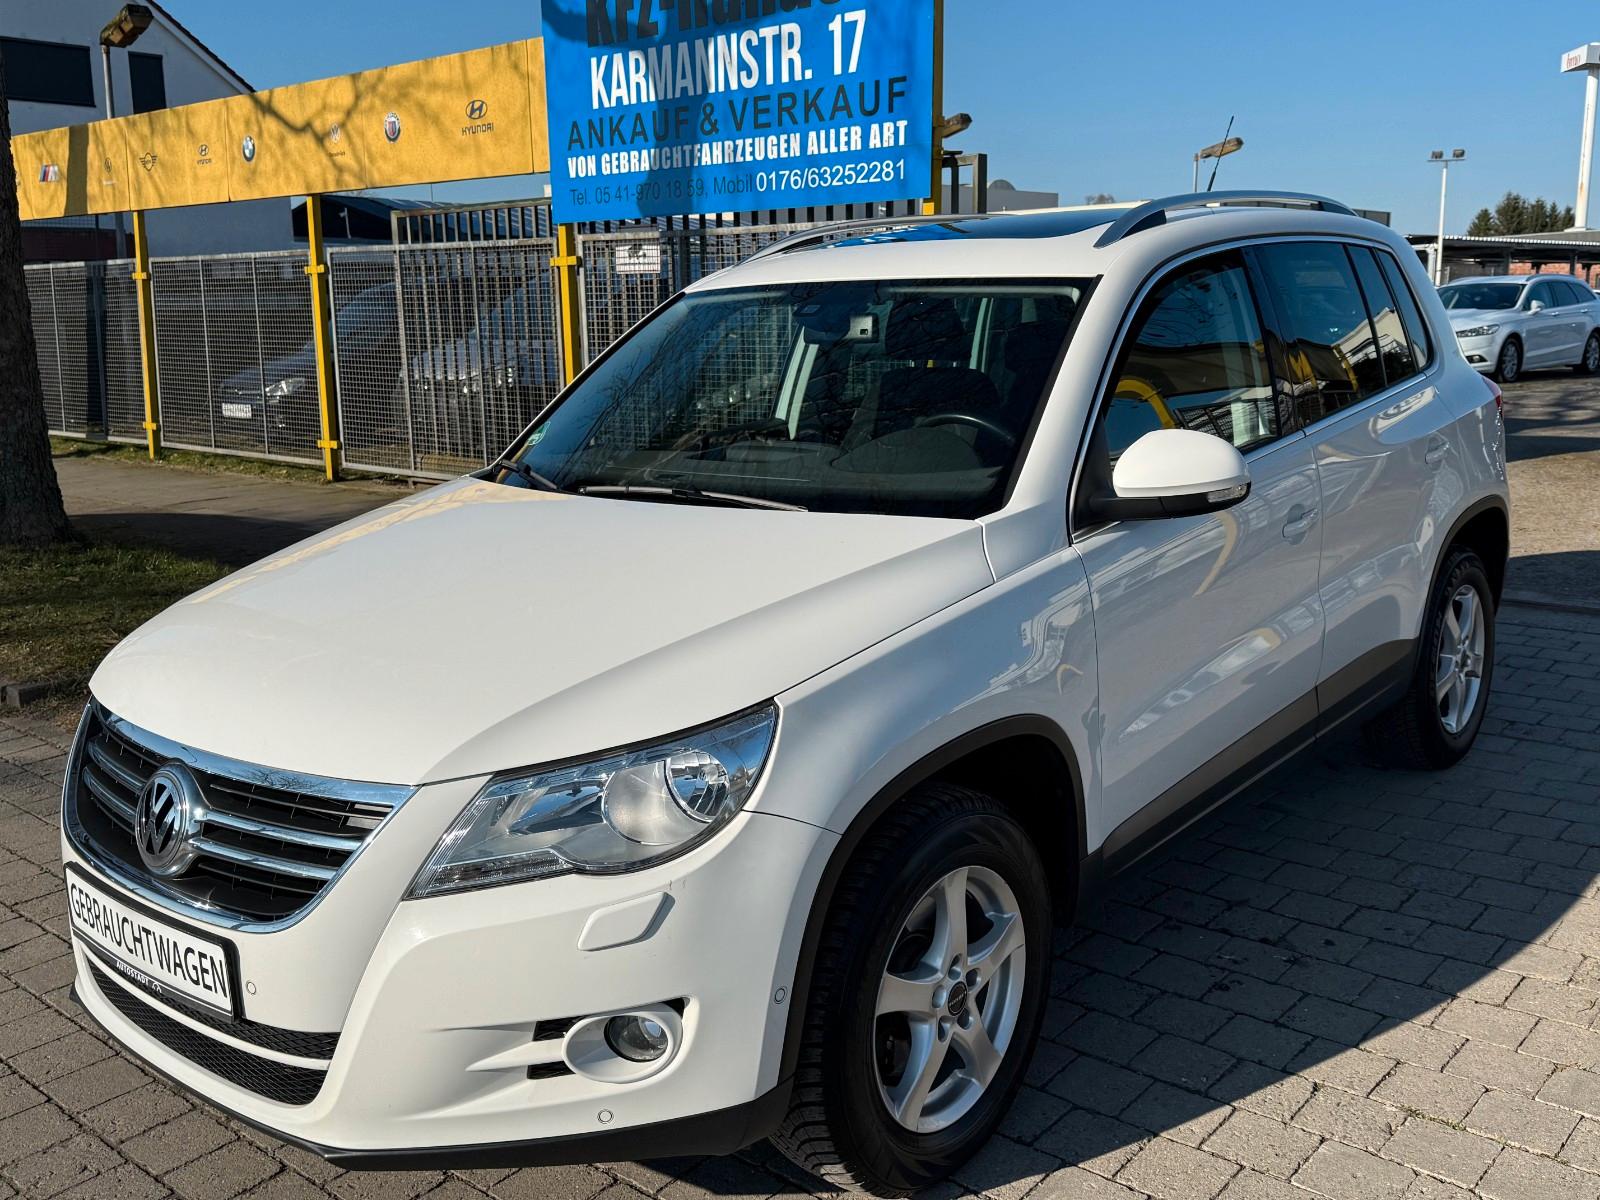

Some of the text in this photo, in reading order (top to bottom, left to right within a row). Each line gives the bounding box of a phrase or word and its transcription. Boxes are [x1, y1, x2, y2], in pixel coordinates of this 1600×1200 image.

[590, 22, 813, 110] KARMANNSTR.
[829, 9, 867, 76] 17
[461, 122, 494, 136] HYUNDAI
[568, 76, 908, 151] ANKAUF & VERKAUF
[567, 120, 908, 178] VON GEBRAUCHTFAHRZEUGEN ALLER ART
[569, 188, 591, 206] Tel.
[595, 186, 611, 204] 05
[615, 181, 661, 202] 41-970
[667, 180, 682, 198] 18
[713, 173, 753, 196] Mobil
[755, 159, 906, 193] 0176/63252281
[70, 882, 228, 999] GEBRAUCHTWAGEN
